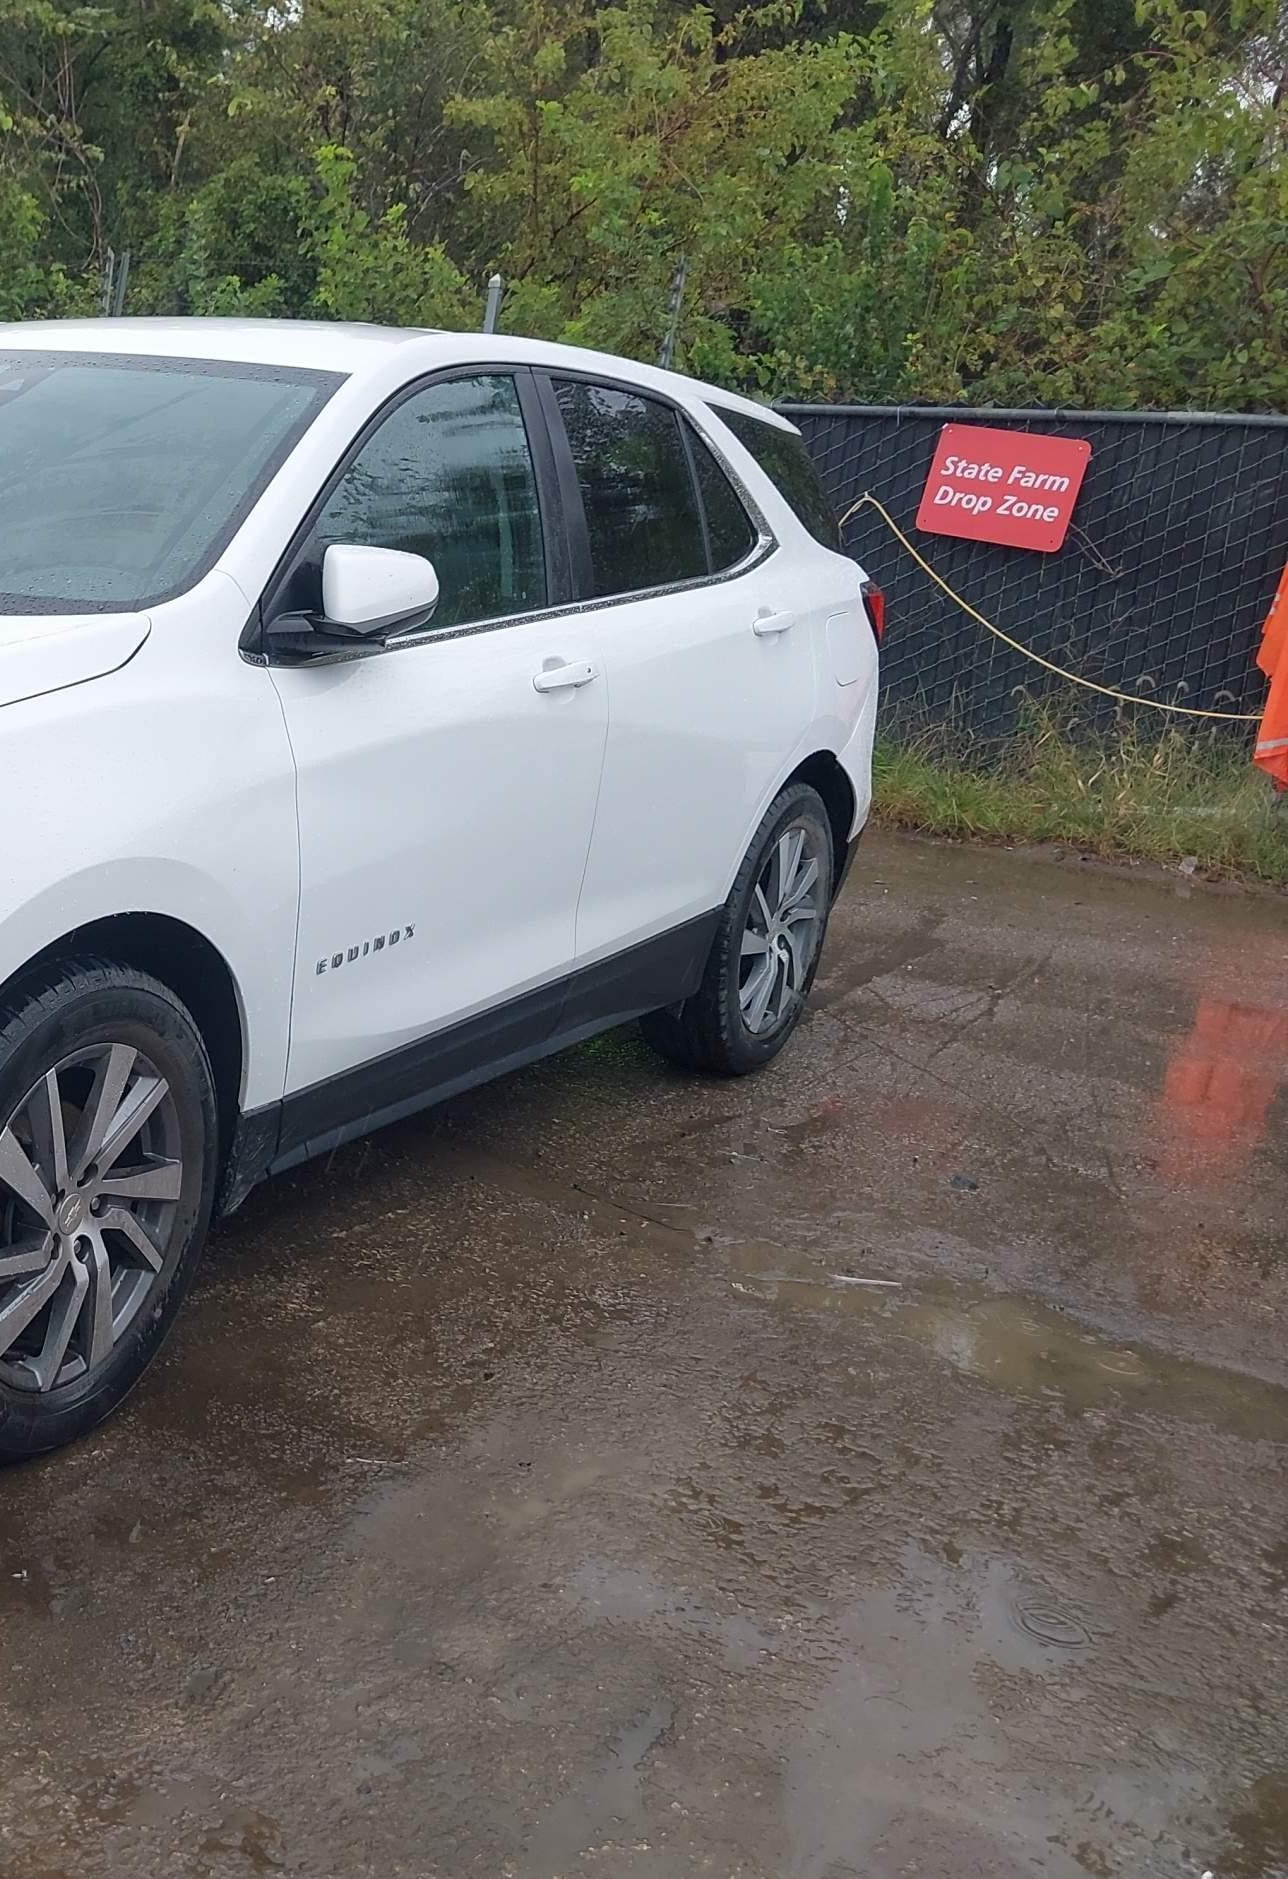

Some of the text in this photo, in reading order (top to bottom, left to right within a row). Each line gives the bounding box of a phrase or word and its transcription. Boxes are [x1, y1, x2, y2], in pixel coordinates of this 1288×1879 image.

[941, 456, 1070, 492] State Farm
[933, 485, 1059, 522] Drop Zone
[316, 923, 416, 976] EQUINOX
